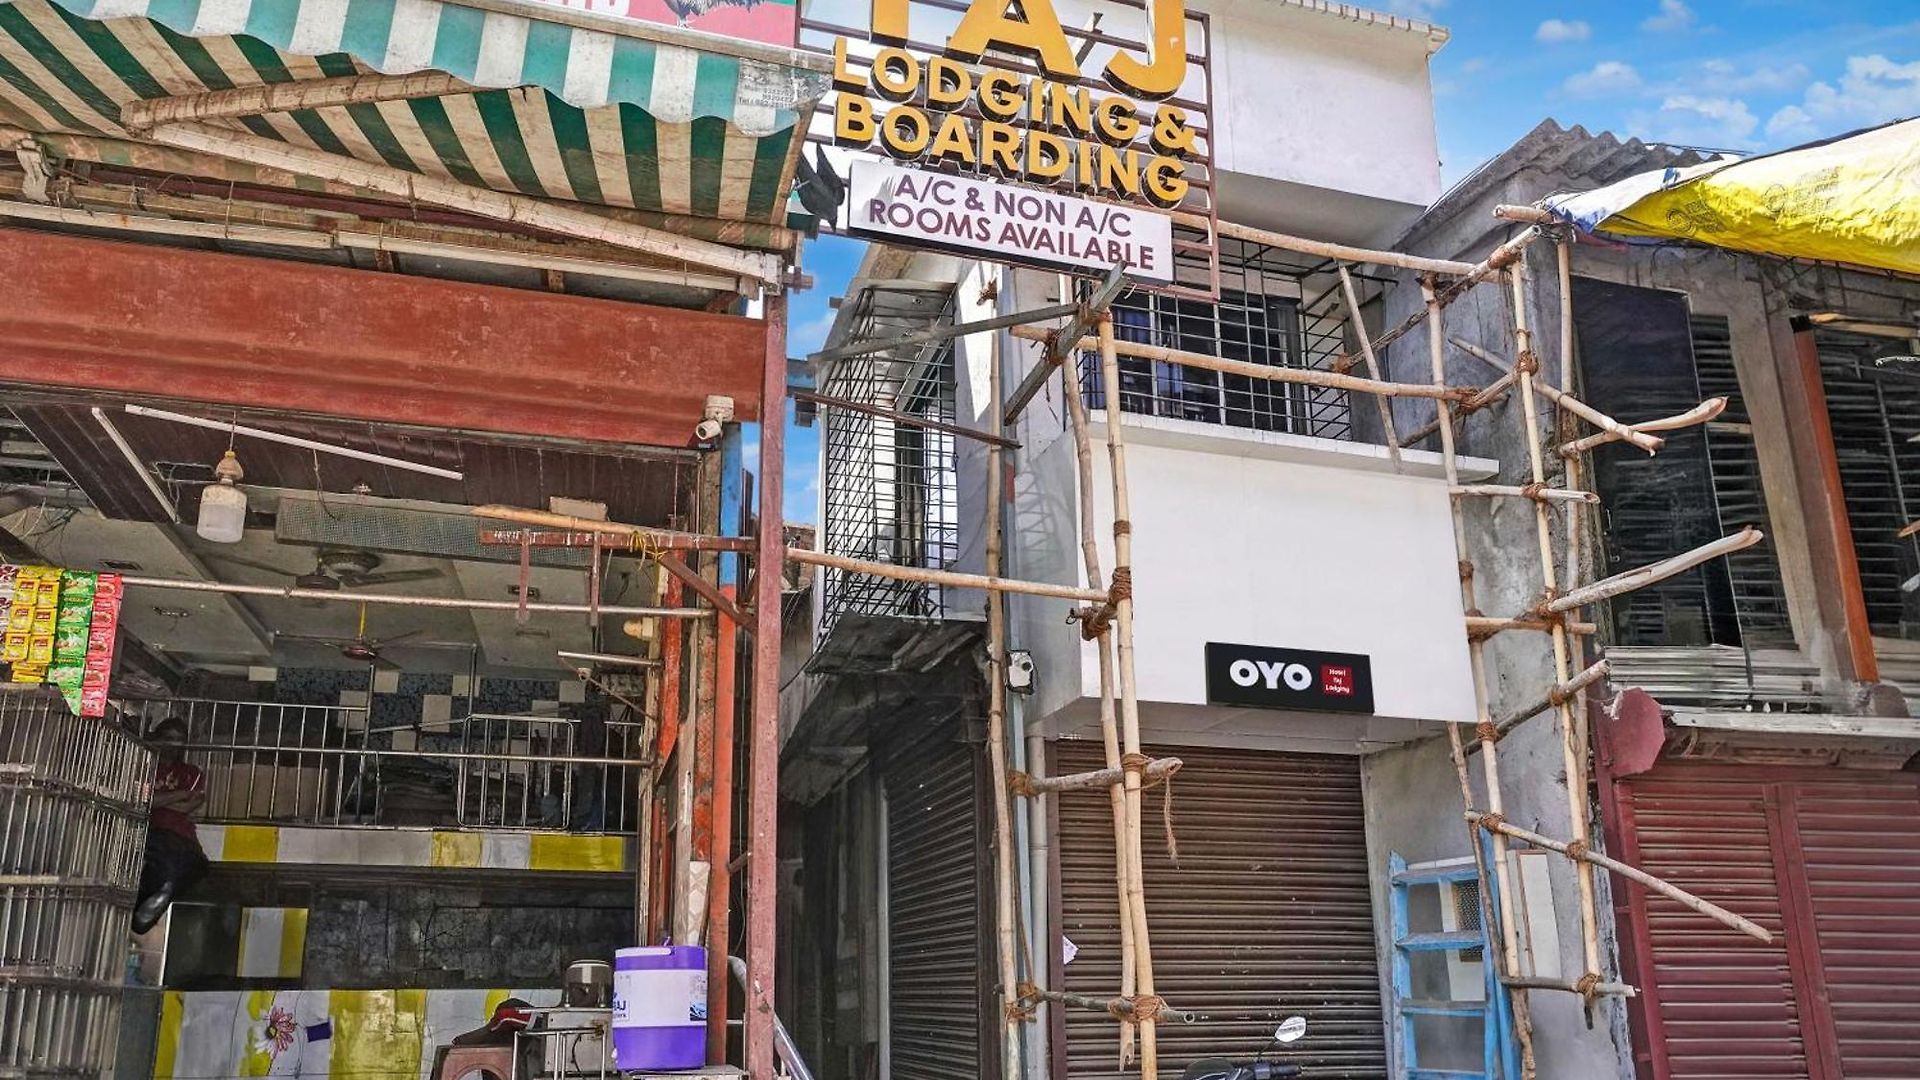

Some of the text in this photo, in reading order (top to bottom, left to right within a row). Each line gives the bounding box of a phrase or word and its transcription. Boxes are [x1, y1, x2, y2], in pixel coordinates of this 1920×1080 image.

[834, 36, 1140, 146] LODGING
[1151, 104, 1198, 156] &
[835, 92, 1189, 206] BOARDING
[869, 199, 1154, 271] ROOMS AVAILABLE
[894, 174, 1132, 238] A/C & NON A/C
[1229, 659, 1313, 691] OYO
